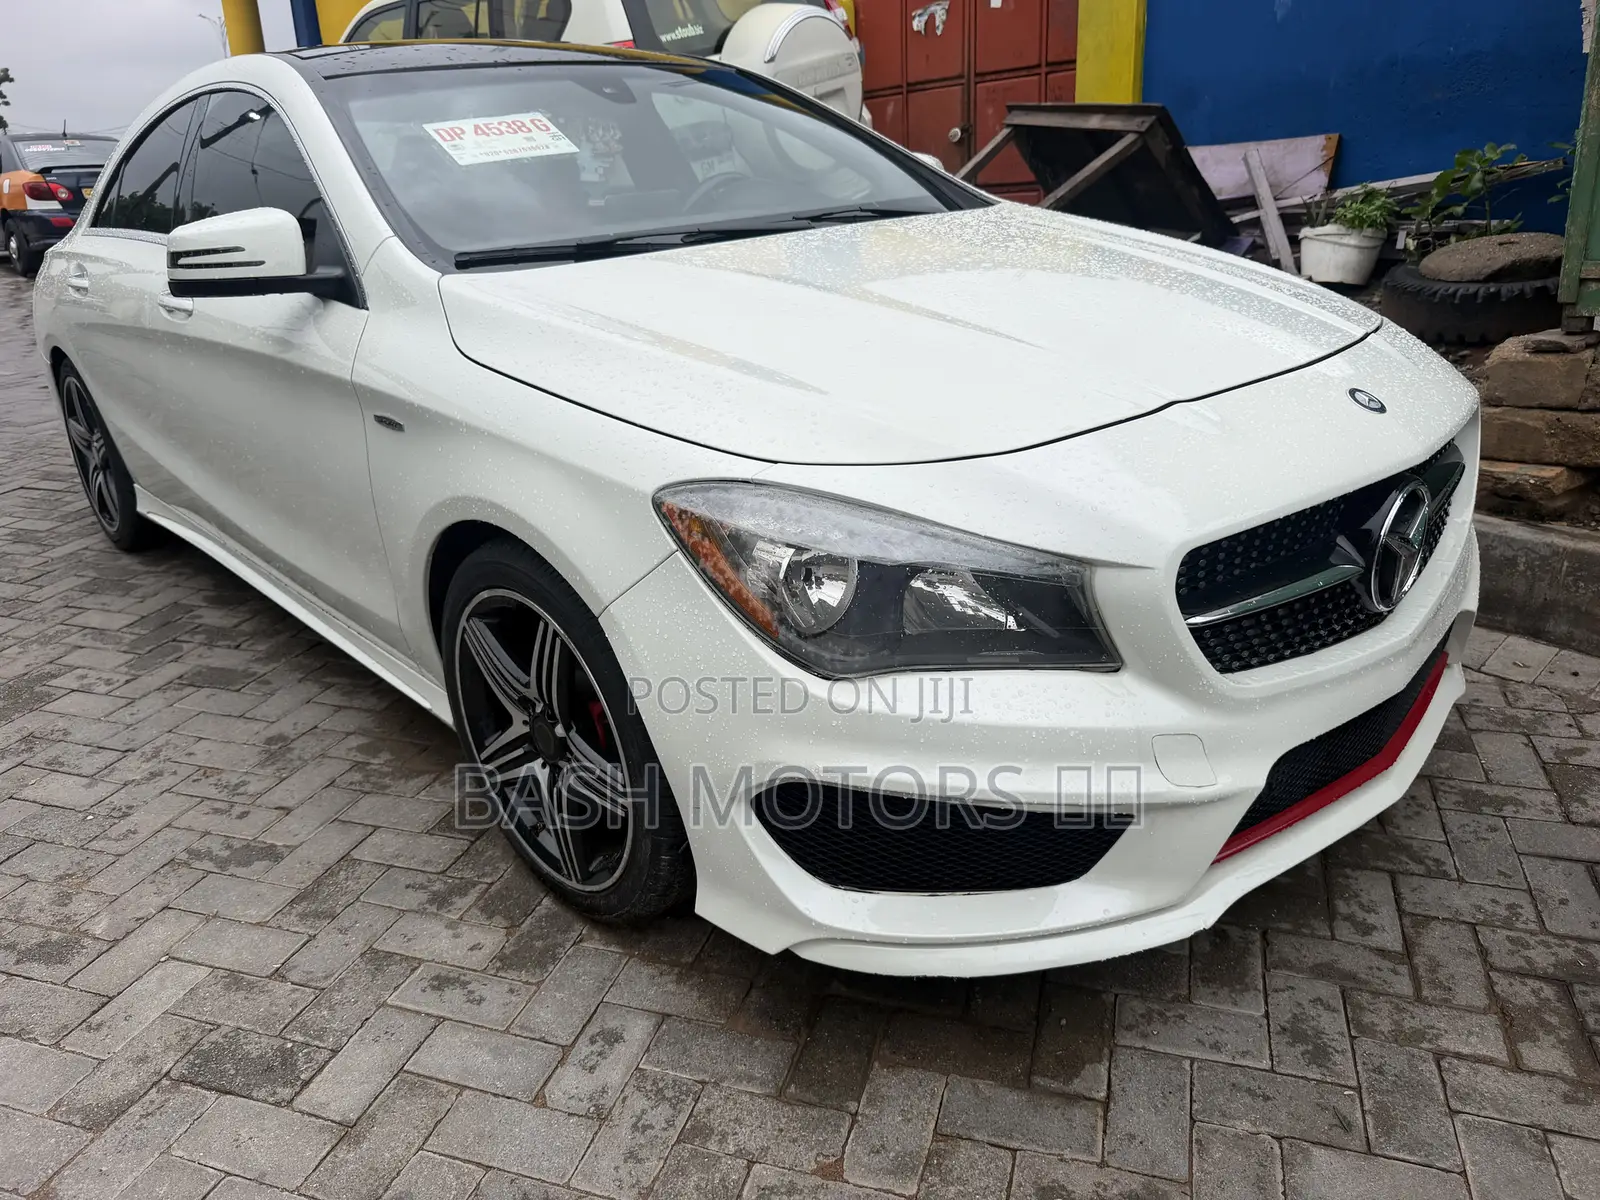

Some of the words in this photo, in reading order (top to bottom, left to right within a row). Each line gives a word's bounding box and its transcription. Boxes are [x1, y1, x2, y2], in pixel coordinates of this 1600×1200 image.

[433, 126, 466, 143] DP
[473, 119, 533, 137] 4538
[529, 118, 551, 132] G
